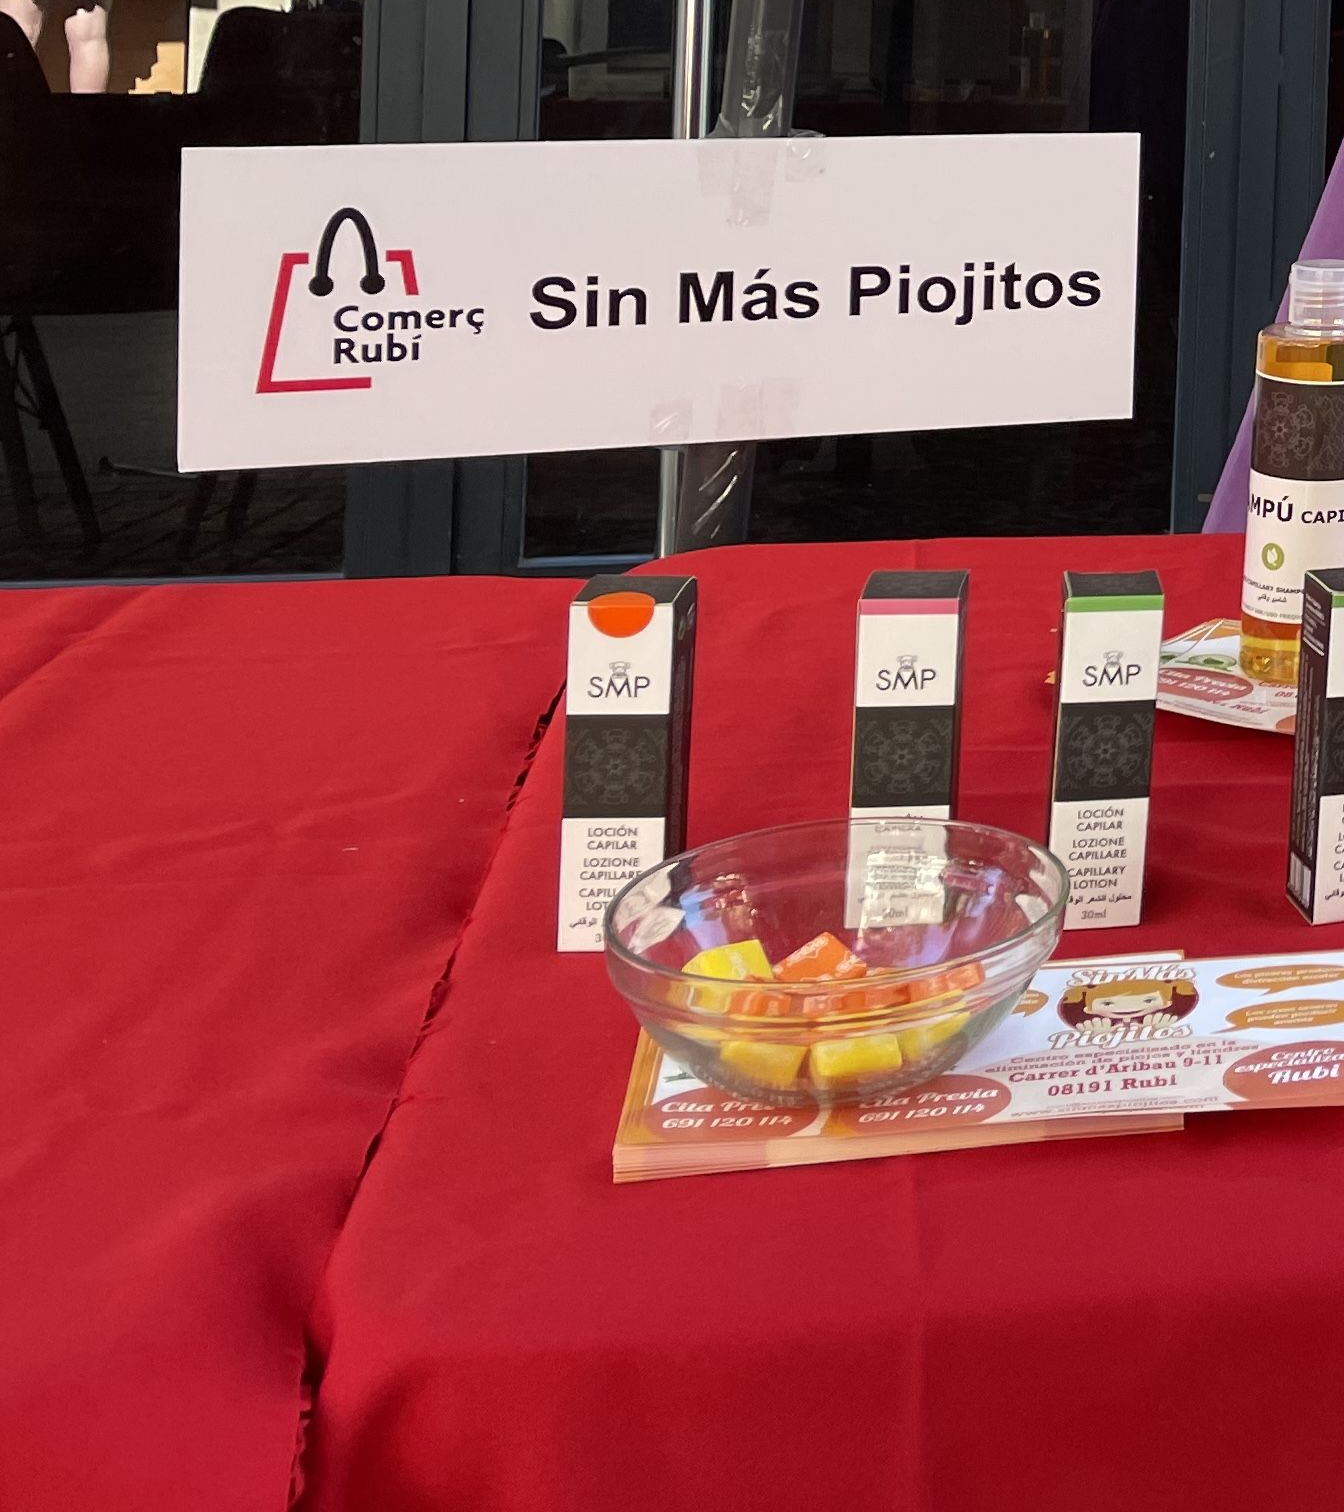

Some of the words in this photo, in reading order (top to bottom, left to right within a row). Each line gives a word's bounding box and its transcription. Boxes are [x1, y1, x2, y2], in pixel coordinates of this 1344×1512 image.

[530, 275, 649, 332] Sin
[679, 268, 822, 325] Más
[848, 260, 1102, 326] Piojitos
[333, 303, 485, 335] Comerç
[332, 331, 421, 364] Rubí
[876, 669, 936, 691] SMP
[1083, 664, 1141, 687] SMP
[587, 675, 651, 699] SMP
[1078, 806, 1124, 819] LOCIÓN
[588, 825, 638, 837] LOCIÓN
[1076, 820, 1122, 831] CAPILAR
[587, 841, 637, 850] CAPILAR
[1072, 836, 1125, 848] LOZIONE
[584, 858, 639, 867] LOZIONE
[1069, 849, 1127, 861] CAPILLARE
[1068, 866, 1126, 877] CAPILLARY
[1073, 879, 1118, 889] LOTION
[1081, 910, 1106, 919] 30ml
[1047, 1022, 1195, 1050] Piojitos
[1010, 1055, 1067, 1065] Centro
[1270, 1047, 1336, 1061] Centro
[1008, 1070, 1080, 1084] Carrer
[1085, 1060, 1177, 1077] d'Aribau
[1182, 1054, 1223, 1068] 9-11
[1268, 1065, 1340, 1085] Rubi
[1047, 1080, 1114, 1097] 08191
[1121, 1074, 1178, 1090] Rubi
[914, 1087, 998, 1104] Previa
[661, 1101, 714, 1113] Cita
[858, 1111, 901, 1124] 691
[908, 1107, 948, 1119] 120
[952, 1103, 985, 1116] 114
[662, 1118, 703, 1130] 691
[710, 1116, 752, 1128] 120
[758, 1114, 793, 1126] 114
